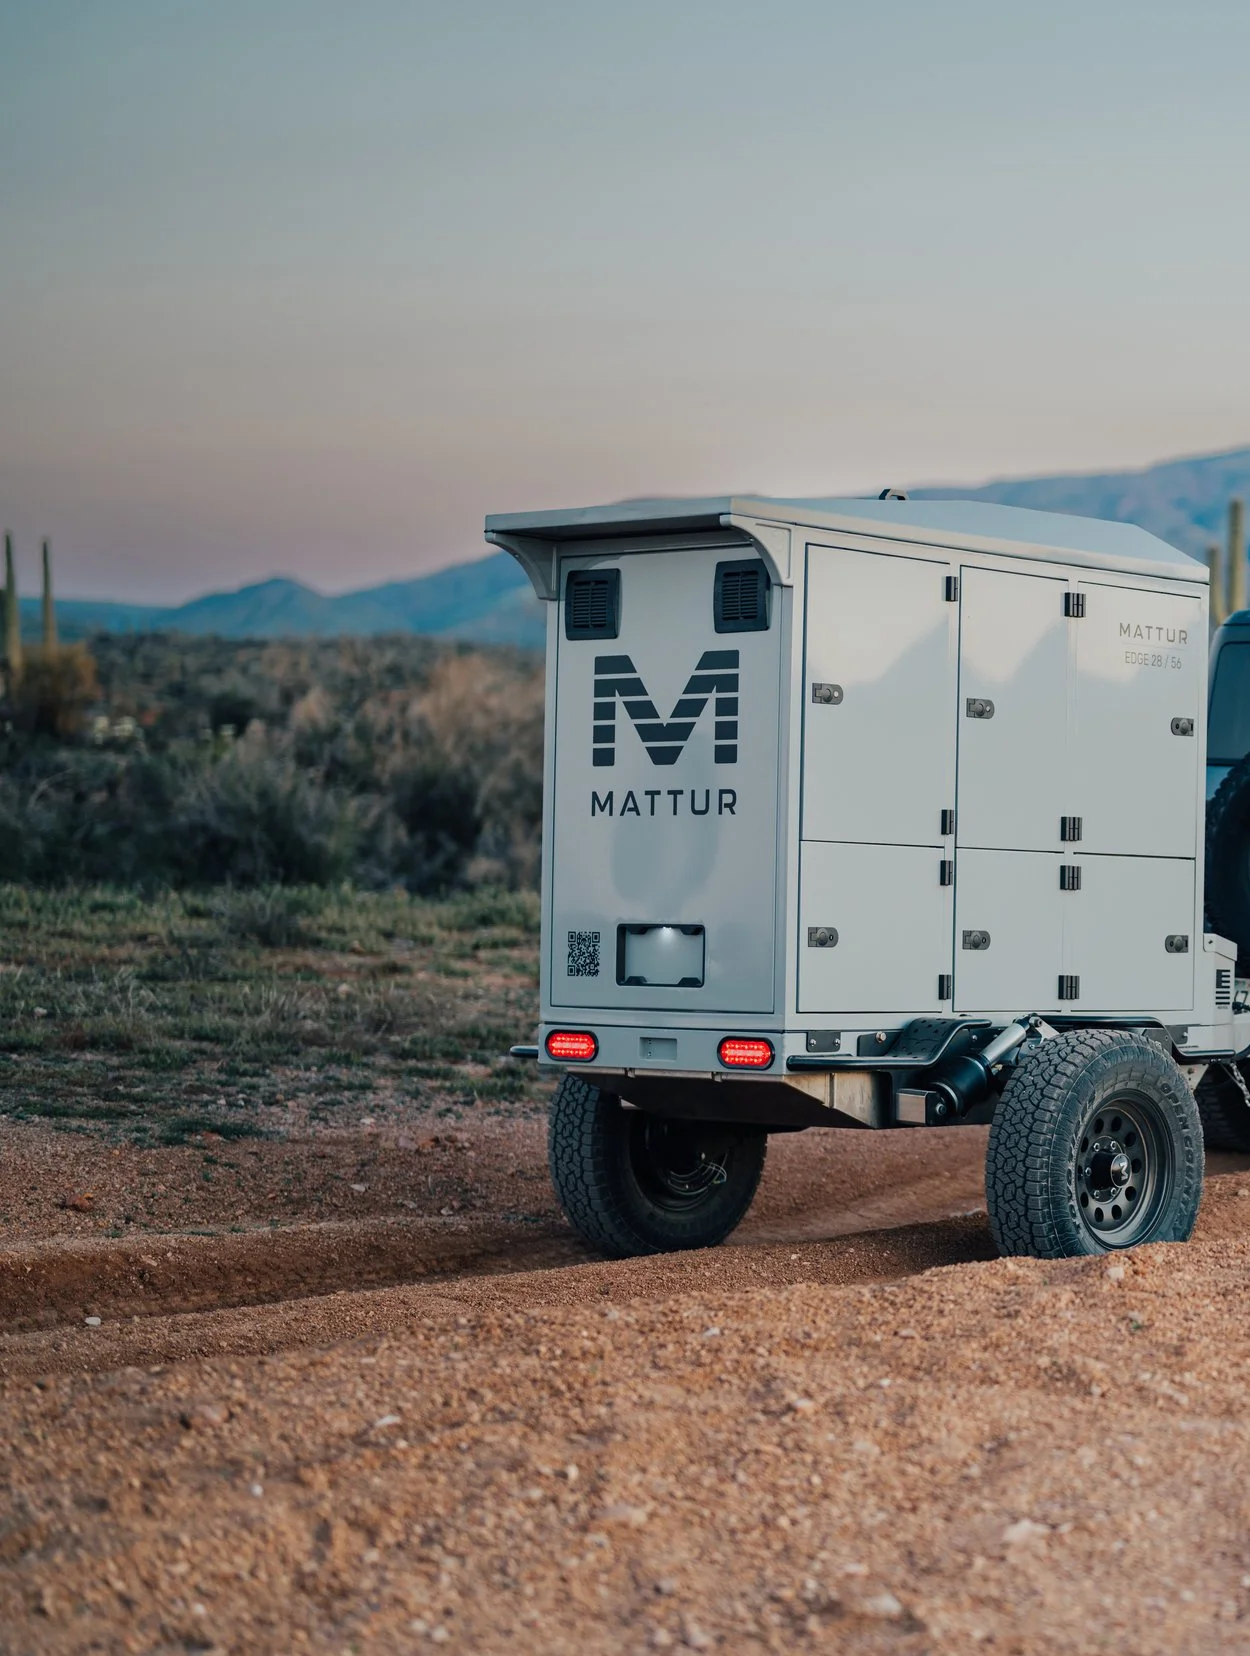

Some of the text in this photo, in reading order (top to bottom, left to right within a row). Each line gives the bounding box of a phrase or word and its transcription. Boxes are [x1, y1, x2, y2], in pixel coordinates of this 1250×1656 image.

[1119, 622, 1188, 645] MATTUR
[1125, 651, 1149, 666] EDGE
[1151, 654, 1163, 668] 28
[1171, 656, 1182, 670] 56
[592, 649, 740, 767] M
[591, 788, 737, 817] MATTUR
